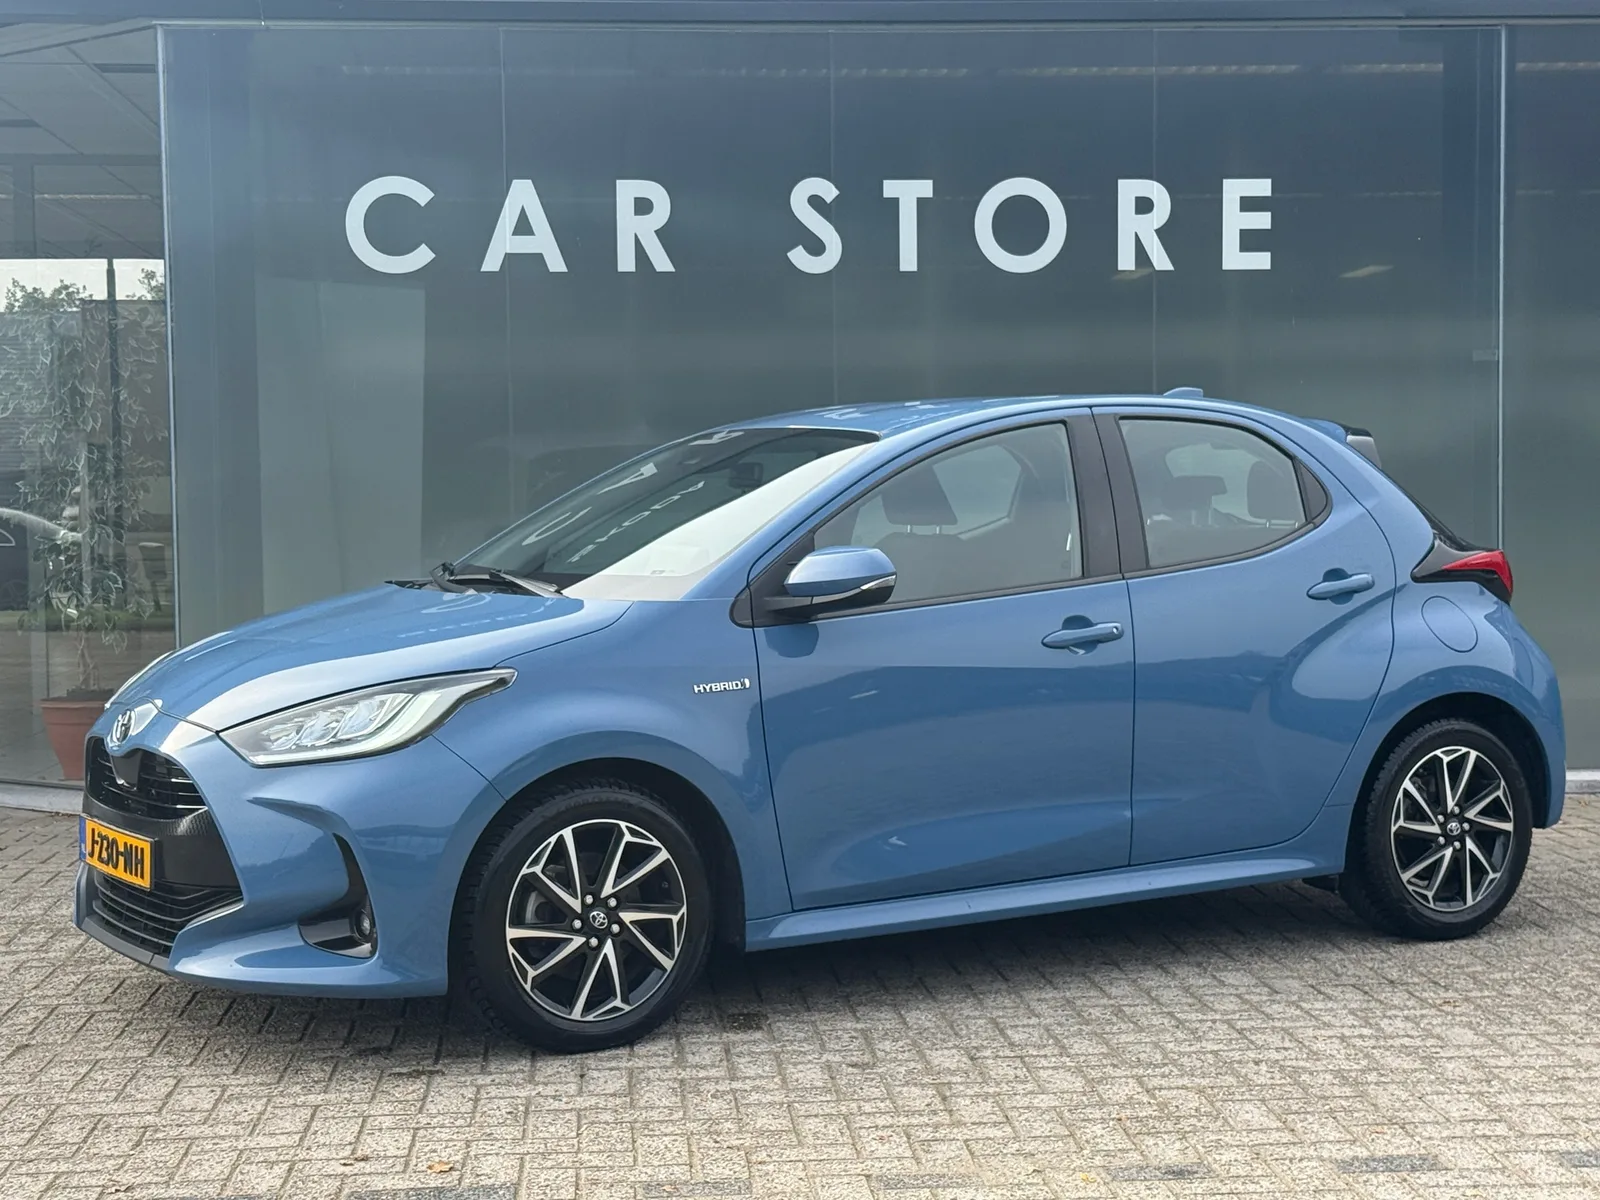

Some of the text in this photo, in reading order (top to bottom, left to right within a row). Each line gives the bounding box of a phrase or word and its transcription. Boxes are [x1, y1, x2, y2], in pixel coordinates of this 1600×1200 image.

[345, 175, 1273, 274] CAR STORE
[693, 679, 743, 694] HYBRID
[87, 827, 145, 880] J-230-NH
